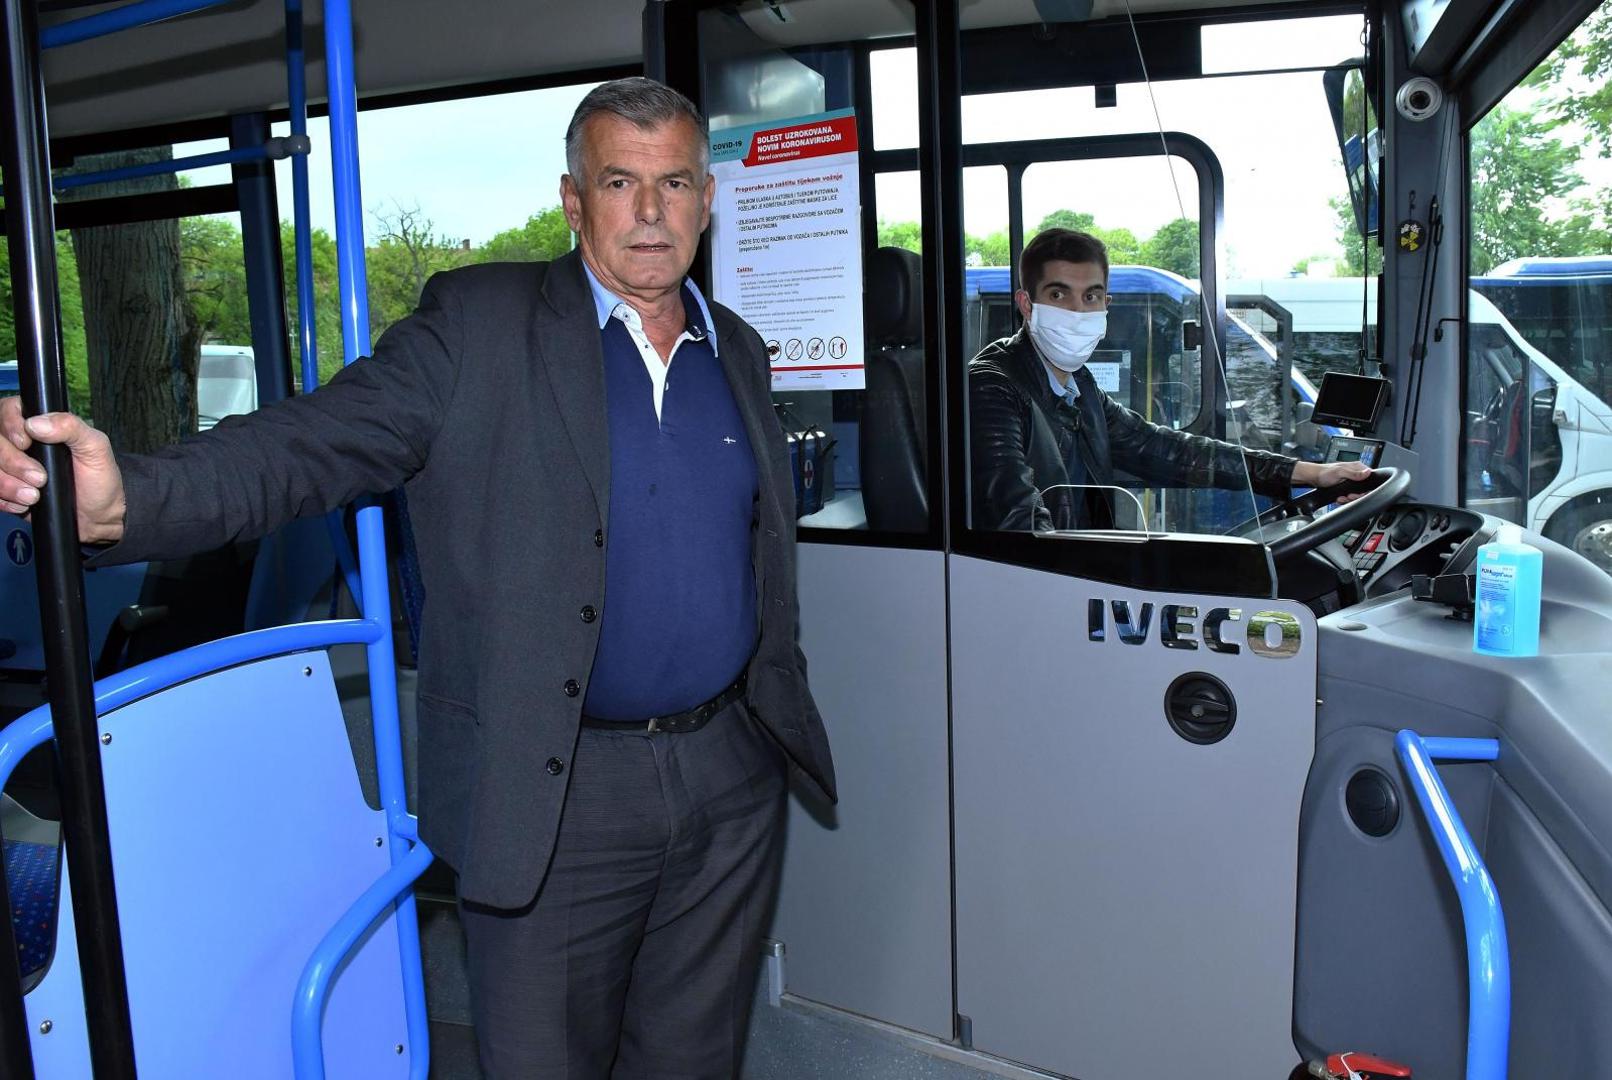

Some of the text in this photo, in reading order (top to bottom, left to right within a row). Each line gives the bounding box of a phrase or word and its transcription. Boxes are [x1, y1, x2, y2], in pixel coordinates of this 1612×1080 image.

[757, 126, 832, 144] BOLEST UZROKOVANA
[757, 133, 842, 153] NOVIM KORONAVIRUSOM
[712, 140, 742, 151] COVID-19
[736, 184, 765, 193] Preporuke
[1088, 598, 1302, 659] IVECO
